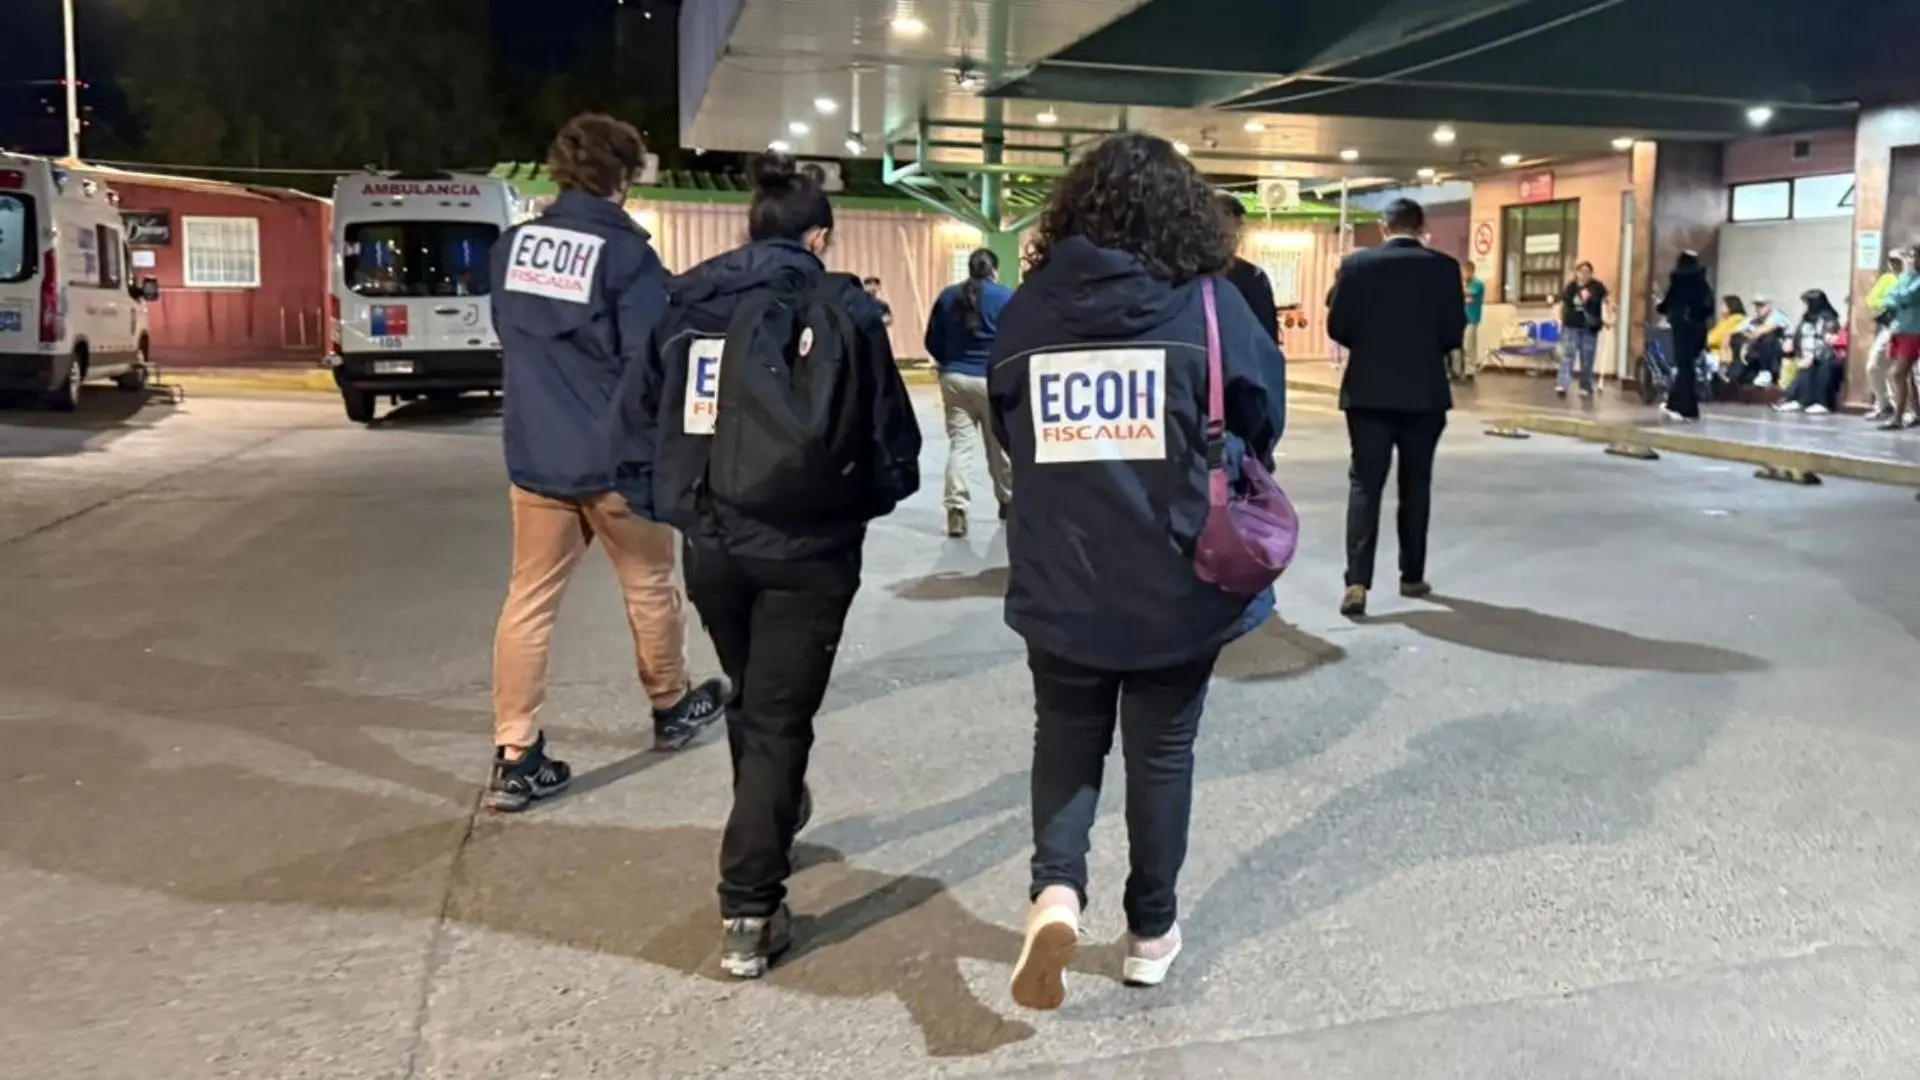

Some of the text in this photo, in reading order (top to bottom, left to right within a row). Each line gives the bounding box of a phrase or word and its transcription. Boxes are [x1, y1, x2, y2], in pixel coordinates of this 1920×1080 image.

[362, 183, 481, 196] AMBULANCIA
[515, 235, 594, 277] ECOH
[510, 270, 583, 292] FISCALIA
[696, 357, 718, 397] E
[1040, 369, 1155, 422] ECOH
[1043, 424, 1155, 442] FISCALIA
